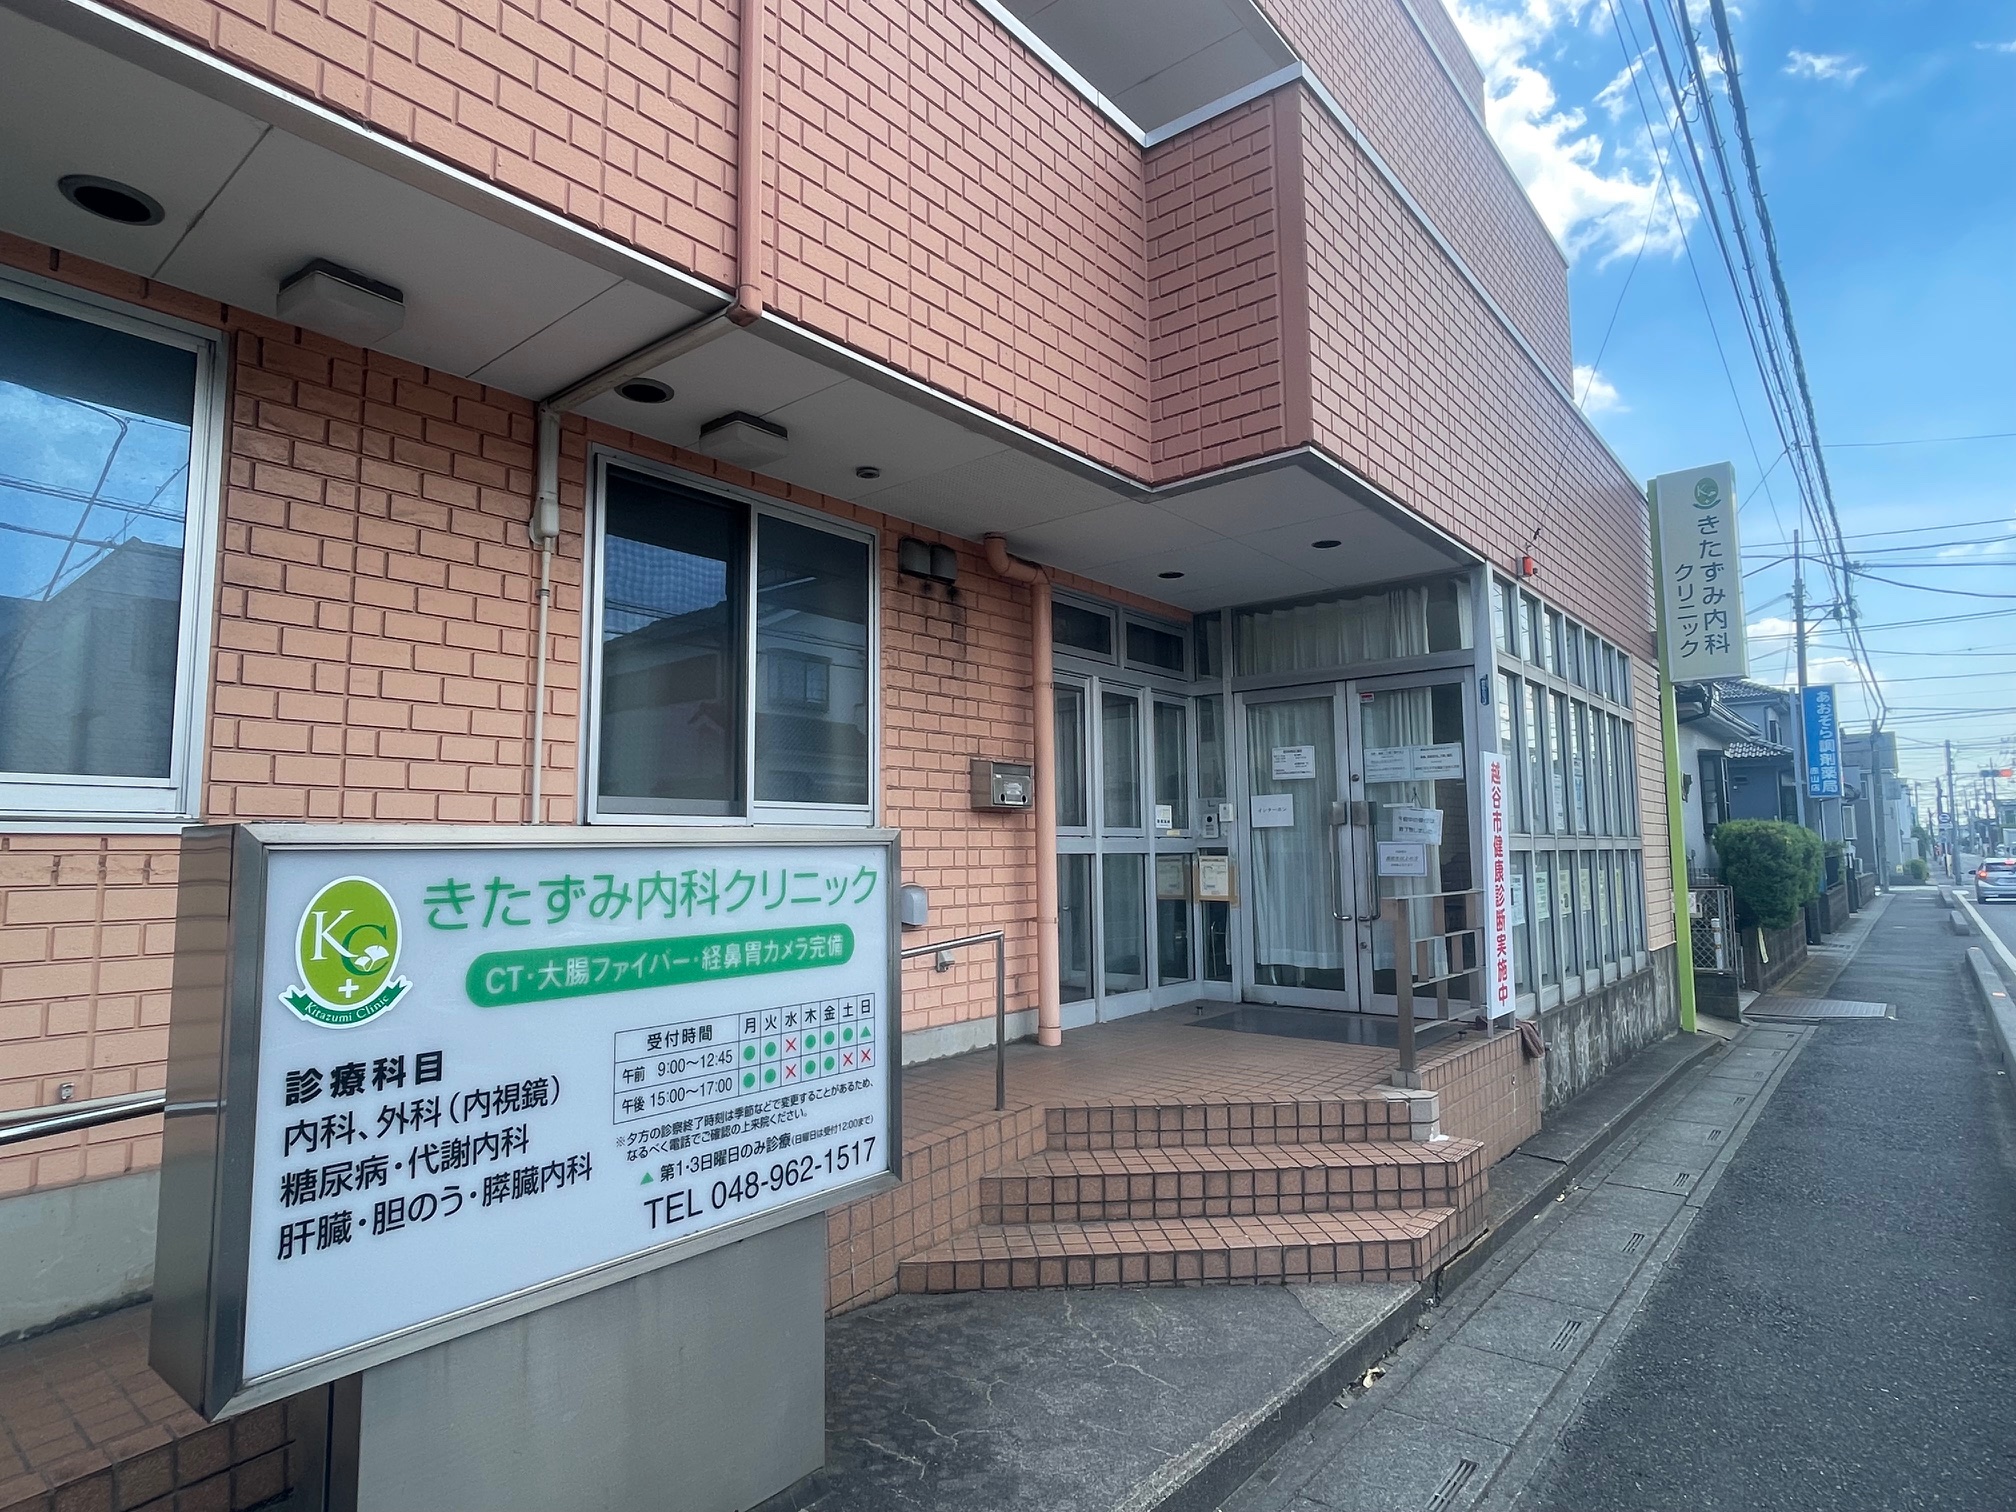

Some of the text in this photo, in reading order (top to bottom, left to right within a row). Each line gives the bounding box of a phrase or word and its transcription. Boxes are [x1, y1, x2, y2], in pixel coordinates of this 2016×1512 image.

[1674, 563, 1699, 658] クリニック
[1697, 515, 1730, 655] きたずみ内科
[1816, 691, 1838, 793] あおぞら調剤薬局
[423, 865, 878, 930] きたずみ内科クリニック
[1491, 761, 1509, 1007] 越谷市健康診断実施中
[485, 933, 843, 993] CT・大腸ファイバー・経鼻胃カメラ完備
[304, 994, 390, 1023] Kitazumi Clinic
[647, 999, 871, 1052] 受付時間 月 火 水 木 金 土 日
[285, 1050, 443, 1107] 診療科目
[622, 1066, 646, 1085] 午前
[622, 1096, 645, 1115] 午後
[280, 1123, 529, 1208] 糖尿病・代謝内科
[626, 1108, 807, 1161] なるべく電話でご確認の上来院ください。
[277, 1151, 592, 1261] 肝臓・胆のう・膵臓内科
[643, 1136, 876, 1230] TEL 048-962-1517
